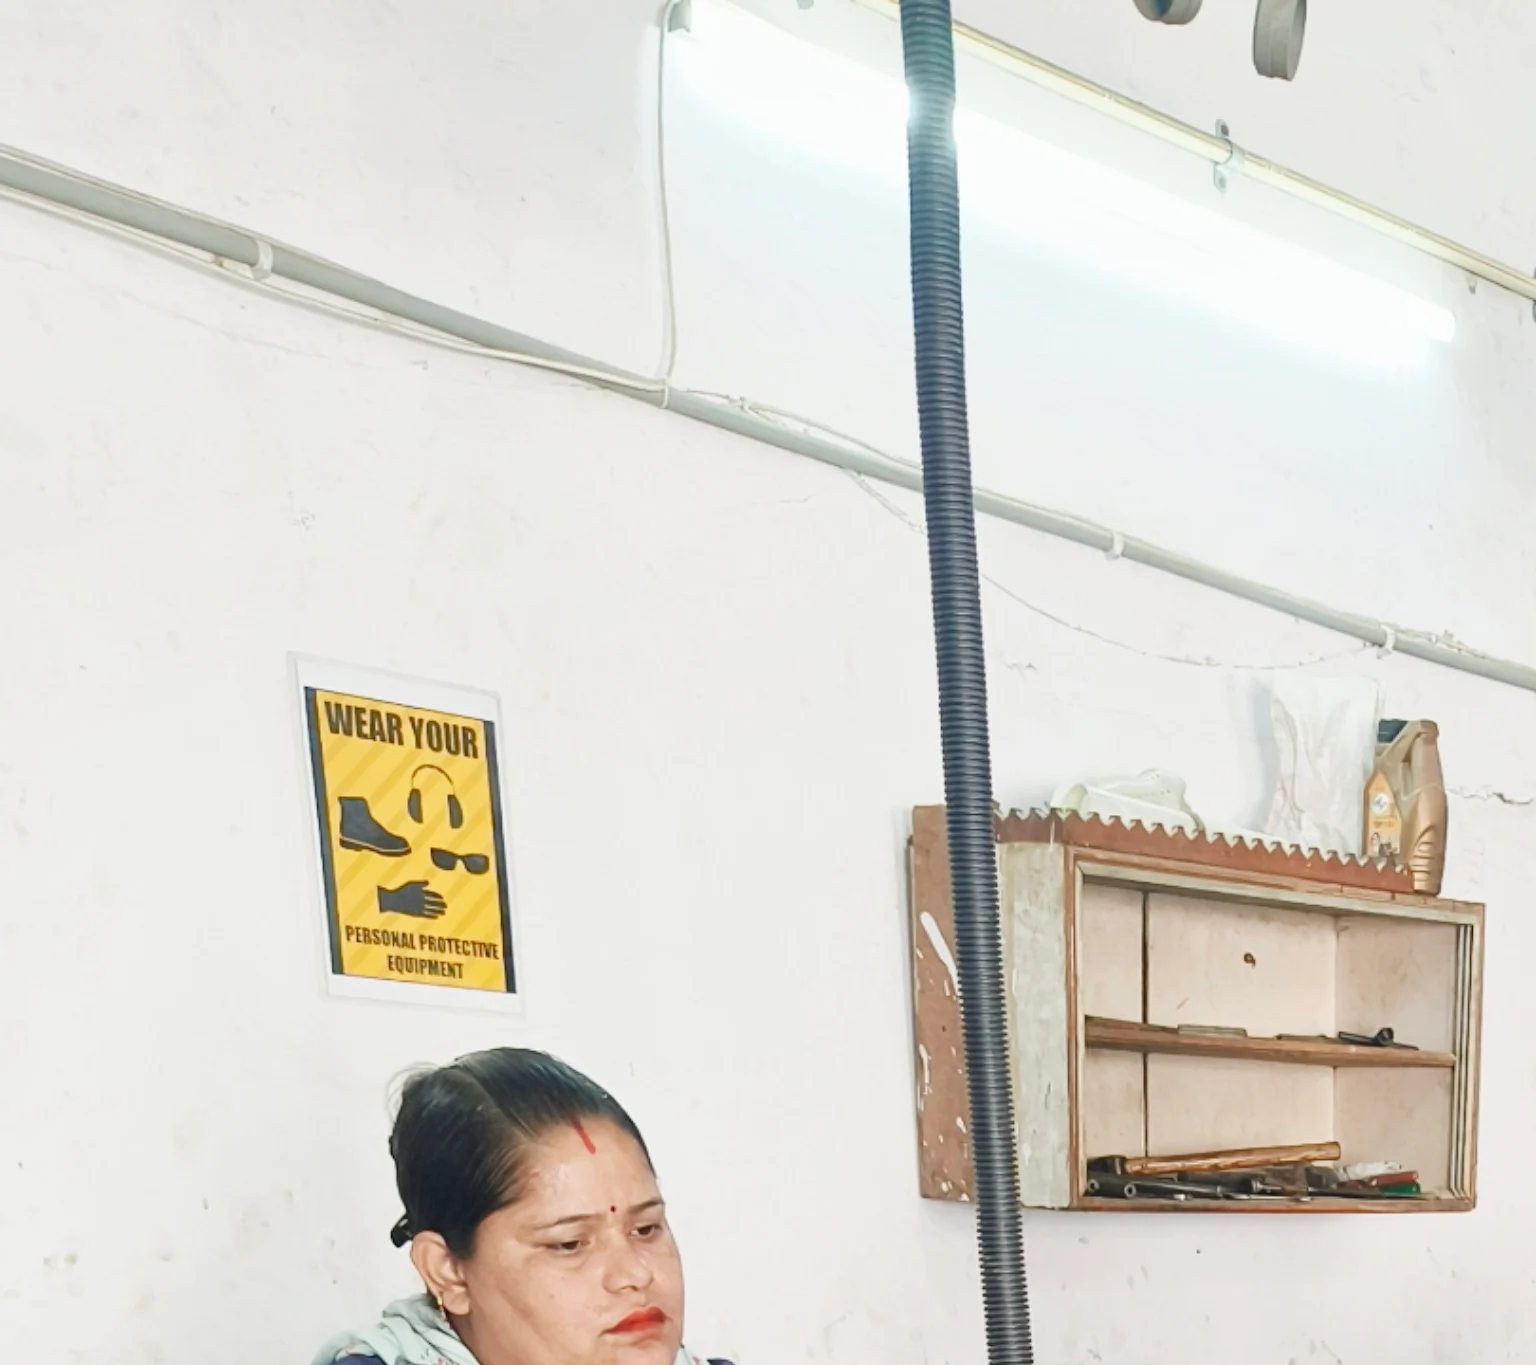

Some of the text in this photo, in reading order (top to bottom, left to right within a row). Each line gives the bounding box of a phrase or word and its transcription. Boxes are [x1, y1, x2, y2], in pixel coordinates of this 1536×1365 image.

[324, 701, 479, 759] WEAR YOUR
[345, 925, 500, 960] PERSONAL PROTECTIVE
[387, 955, 464, 979] EQUIPMENT
